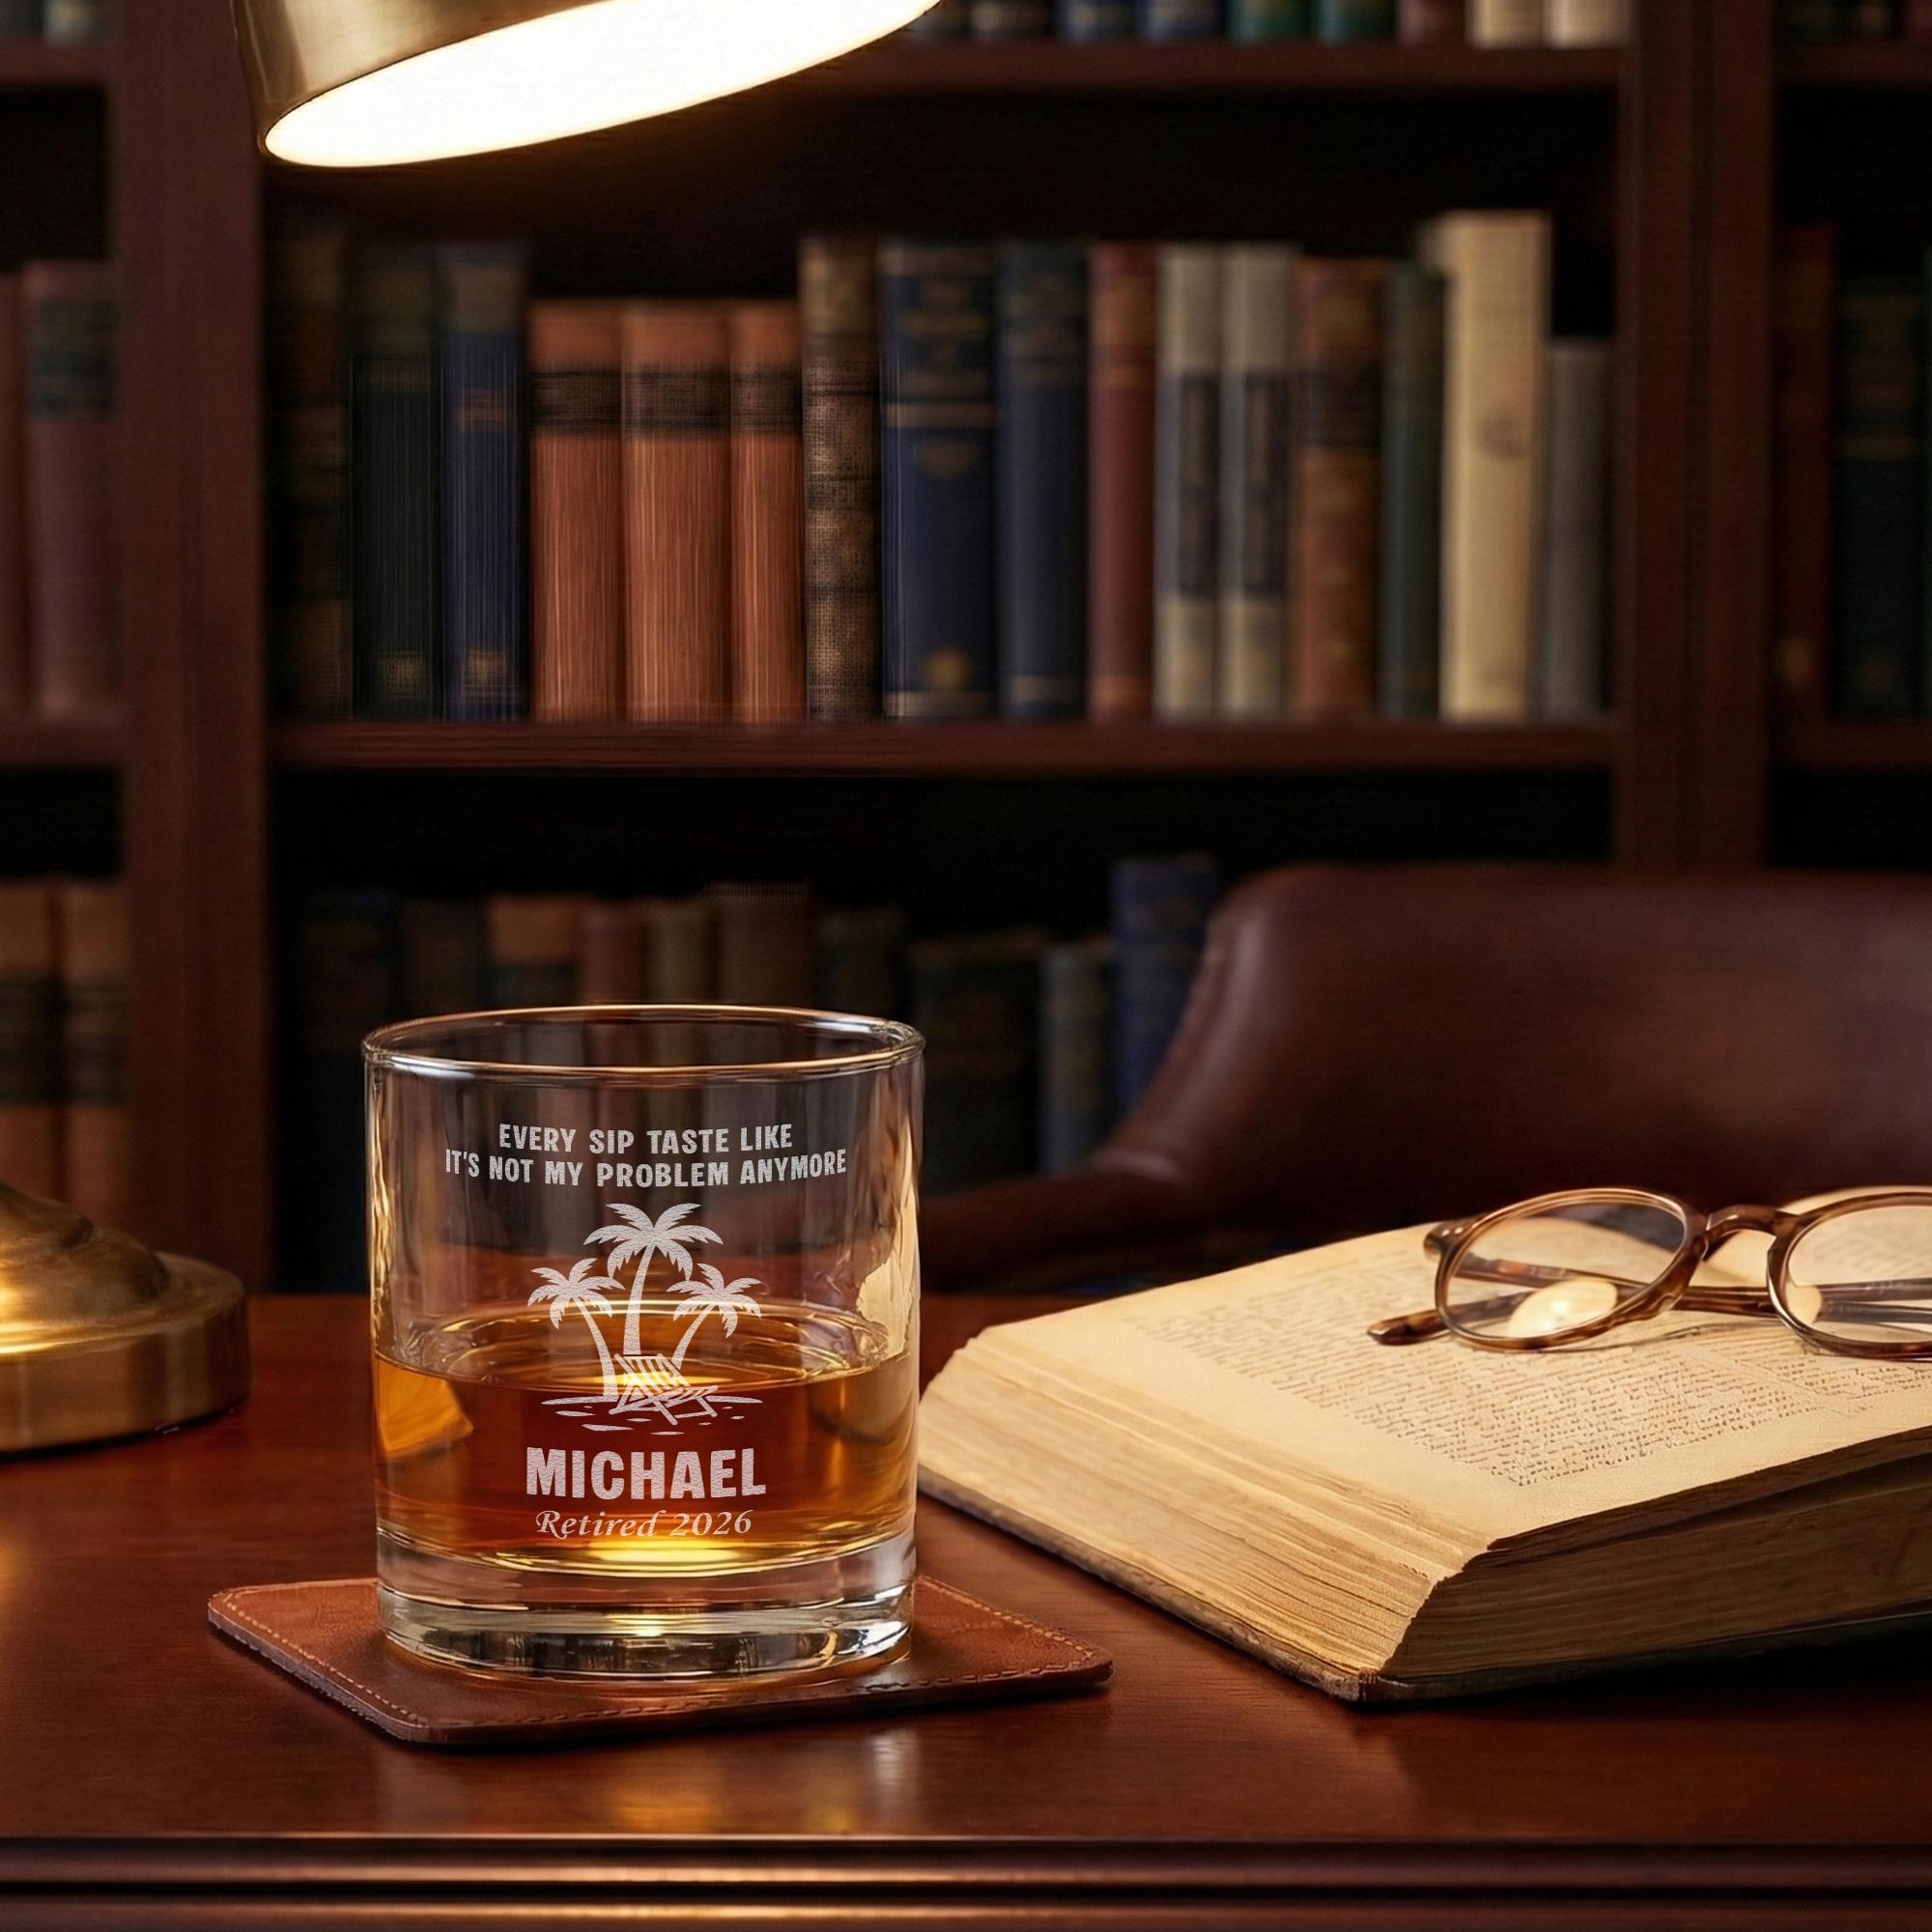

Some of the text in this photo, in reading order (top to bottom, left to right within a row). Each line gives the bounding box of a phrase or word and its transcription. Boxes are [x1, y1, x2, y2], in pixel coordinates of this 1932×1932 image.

[498, 1123, 792, 1154] EVERY SIP TASTE LIKE
[445, 1149, 846, 1188] IT'S NOT MY PROBLEM ANYMORE
[526, 1446, 766, 1500] MICHAEL
[535, 1509, 754, 1540] Retired 2026
